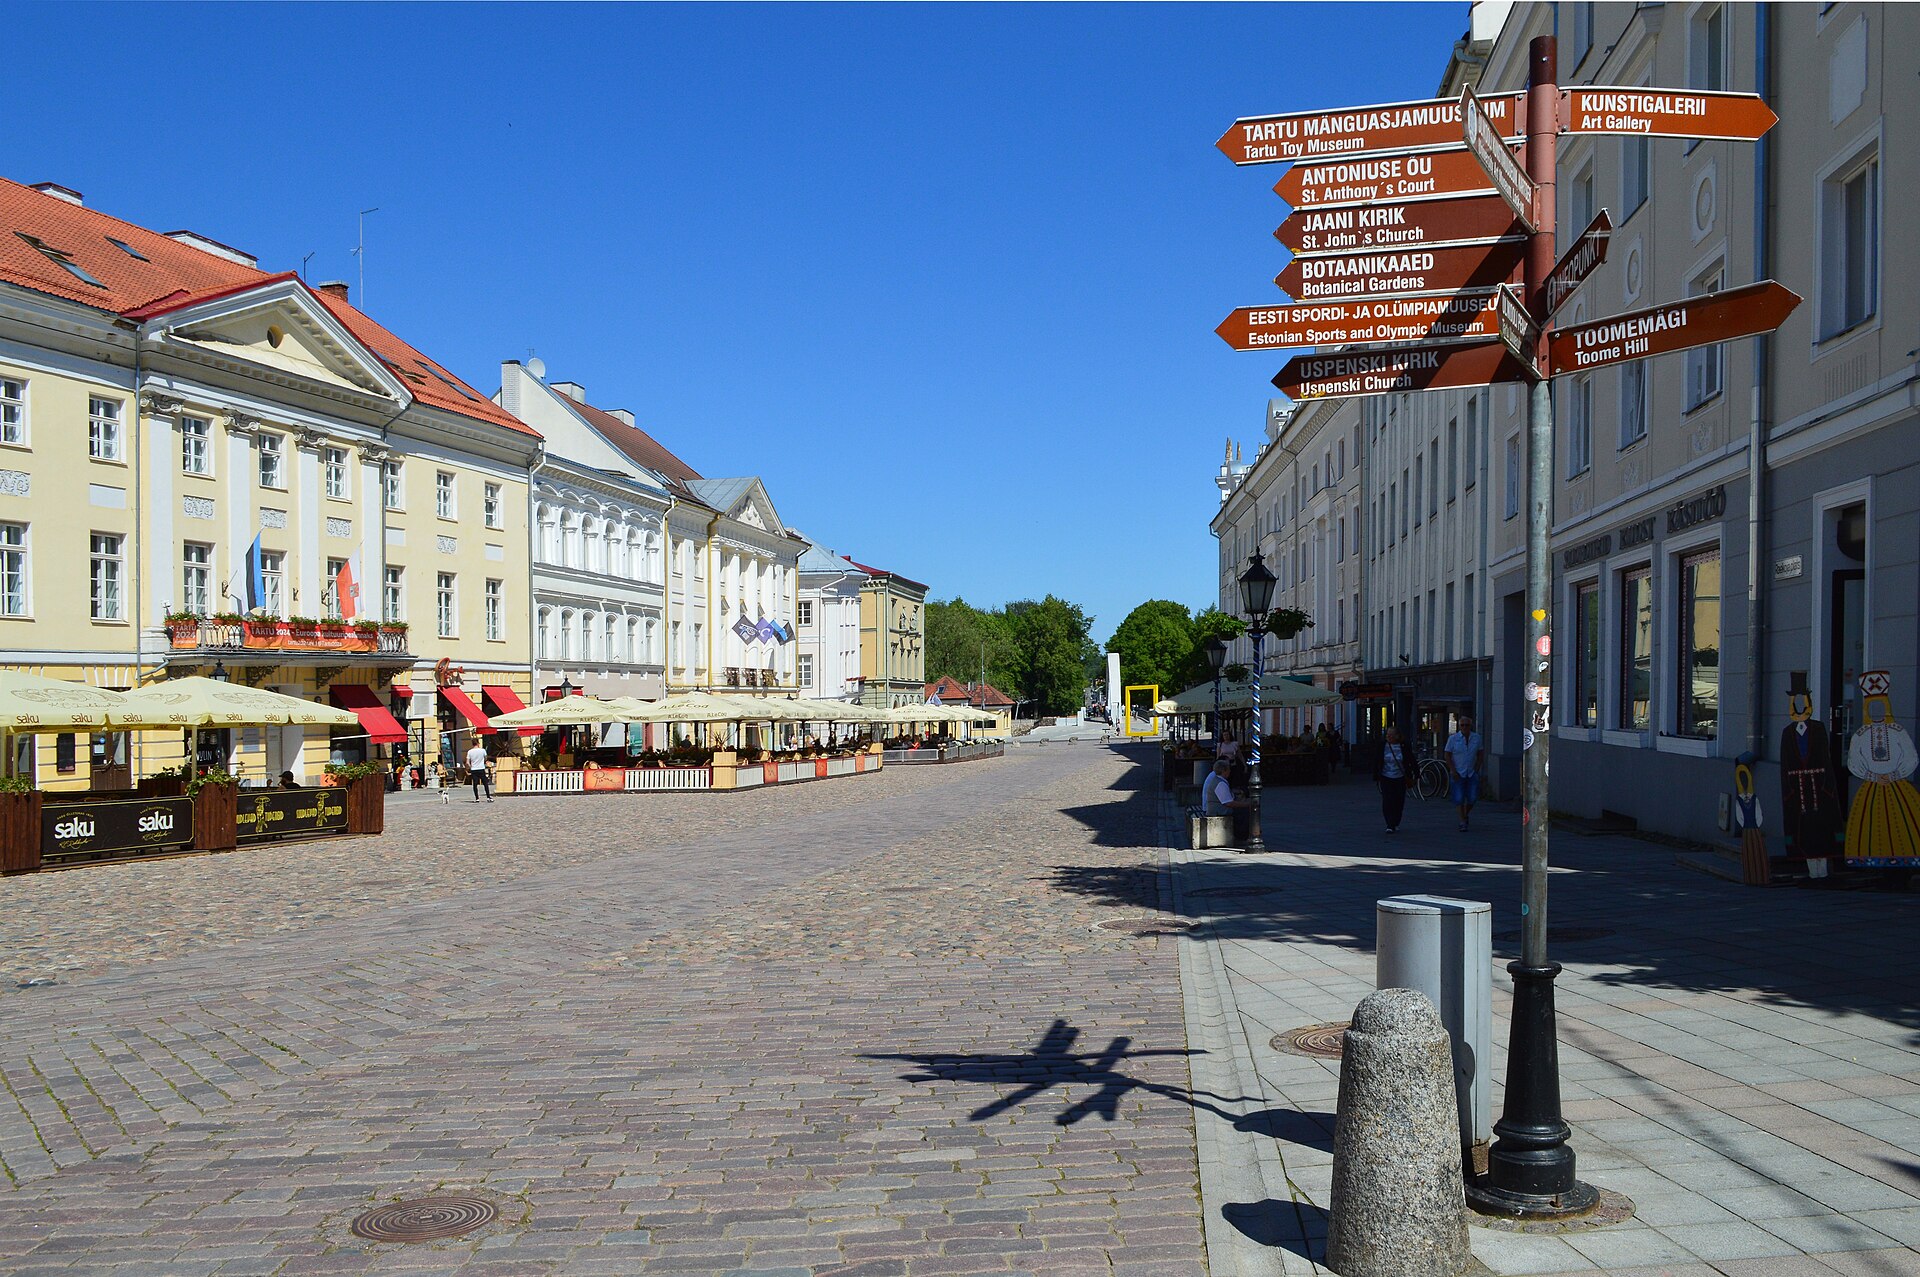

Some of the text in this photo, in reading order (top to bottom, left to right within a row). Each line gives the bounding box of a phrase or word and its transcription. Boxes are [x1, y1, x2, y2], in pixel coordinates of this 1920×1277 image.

[1581, 94, 1706, 116] KUNSTIGALERII
[1243, 121, 1298, 142] TARTU
[1581, 114, 1652, 133] Art Gallery
[1244, 137, 1364, 159] Tartu Toy Museum
[1302, 155, 1431, 186] ANTONIUSE ÕU
[1302, 189, 1319, 203] St.
[1397, 178, 1435, 194] Court
[1302, 207, 1405, 232] JAANI KIRIK
[1302, 235, 1320, 249] St.
[1376, 226, 1424, 243] Church
[1302, 253, 1434, 279] BOTAANIKAAED
[1302, 276, 1425, 296] Botanical Gardens
[1248, 310, 1288, 325] EESTI
[1292, 307, 1349, 322] SPORDI-
[1352, 305, 1371, 319] JA
[1248, 322, 1484, 345] Estonian Sports and Olympic Museum
[1573, 308, 1687, 349] TOOMEMÄGI
[1575, 337, 1649, 366] Toome Hill
[1300, 351, 1439, 378] USPENSKI KIRIK
[1300, 374, 1412, 396] Uspenski Church
[16, 713, 40, 724] saku
[71, 713, 93, 723] saku
[123, 713, 143, 723] saku
[169, 713, 188, 722] saku
[226, 712, 243, 721] saku
[265, 713, 280, 721] saku
[301, 714, 316, 722] saku
[54, 816, 96, 839] saku
[138, 811, 174, 832] saku
